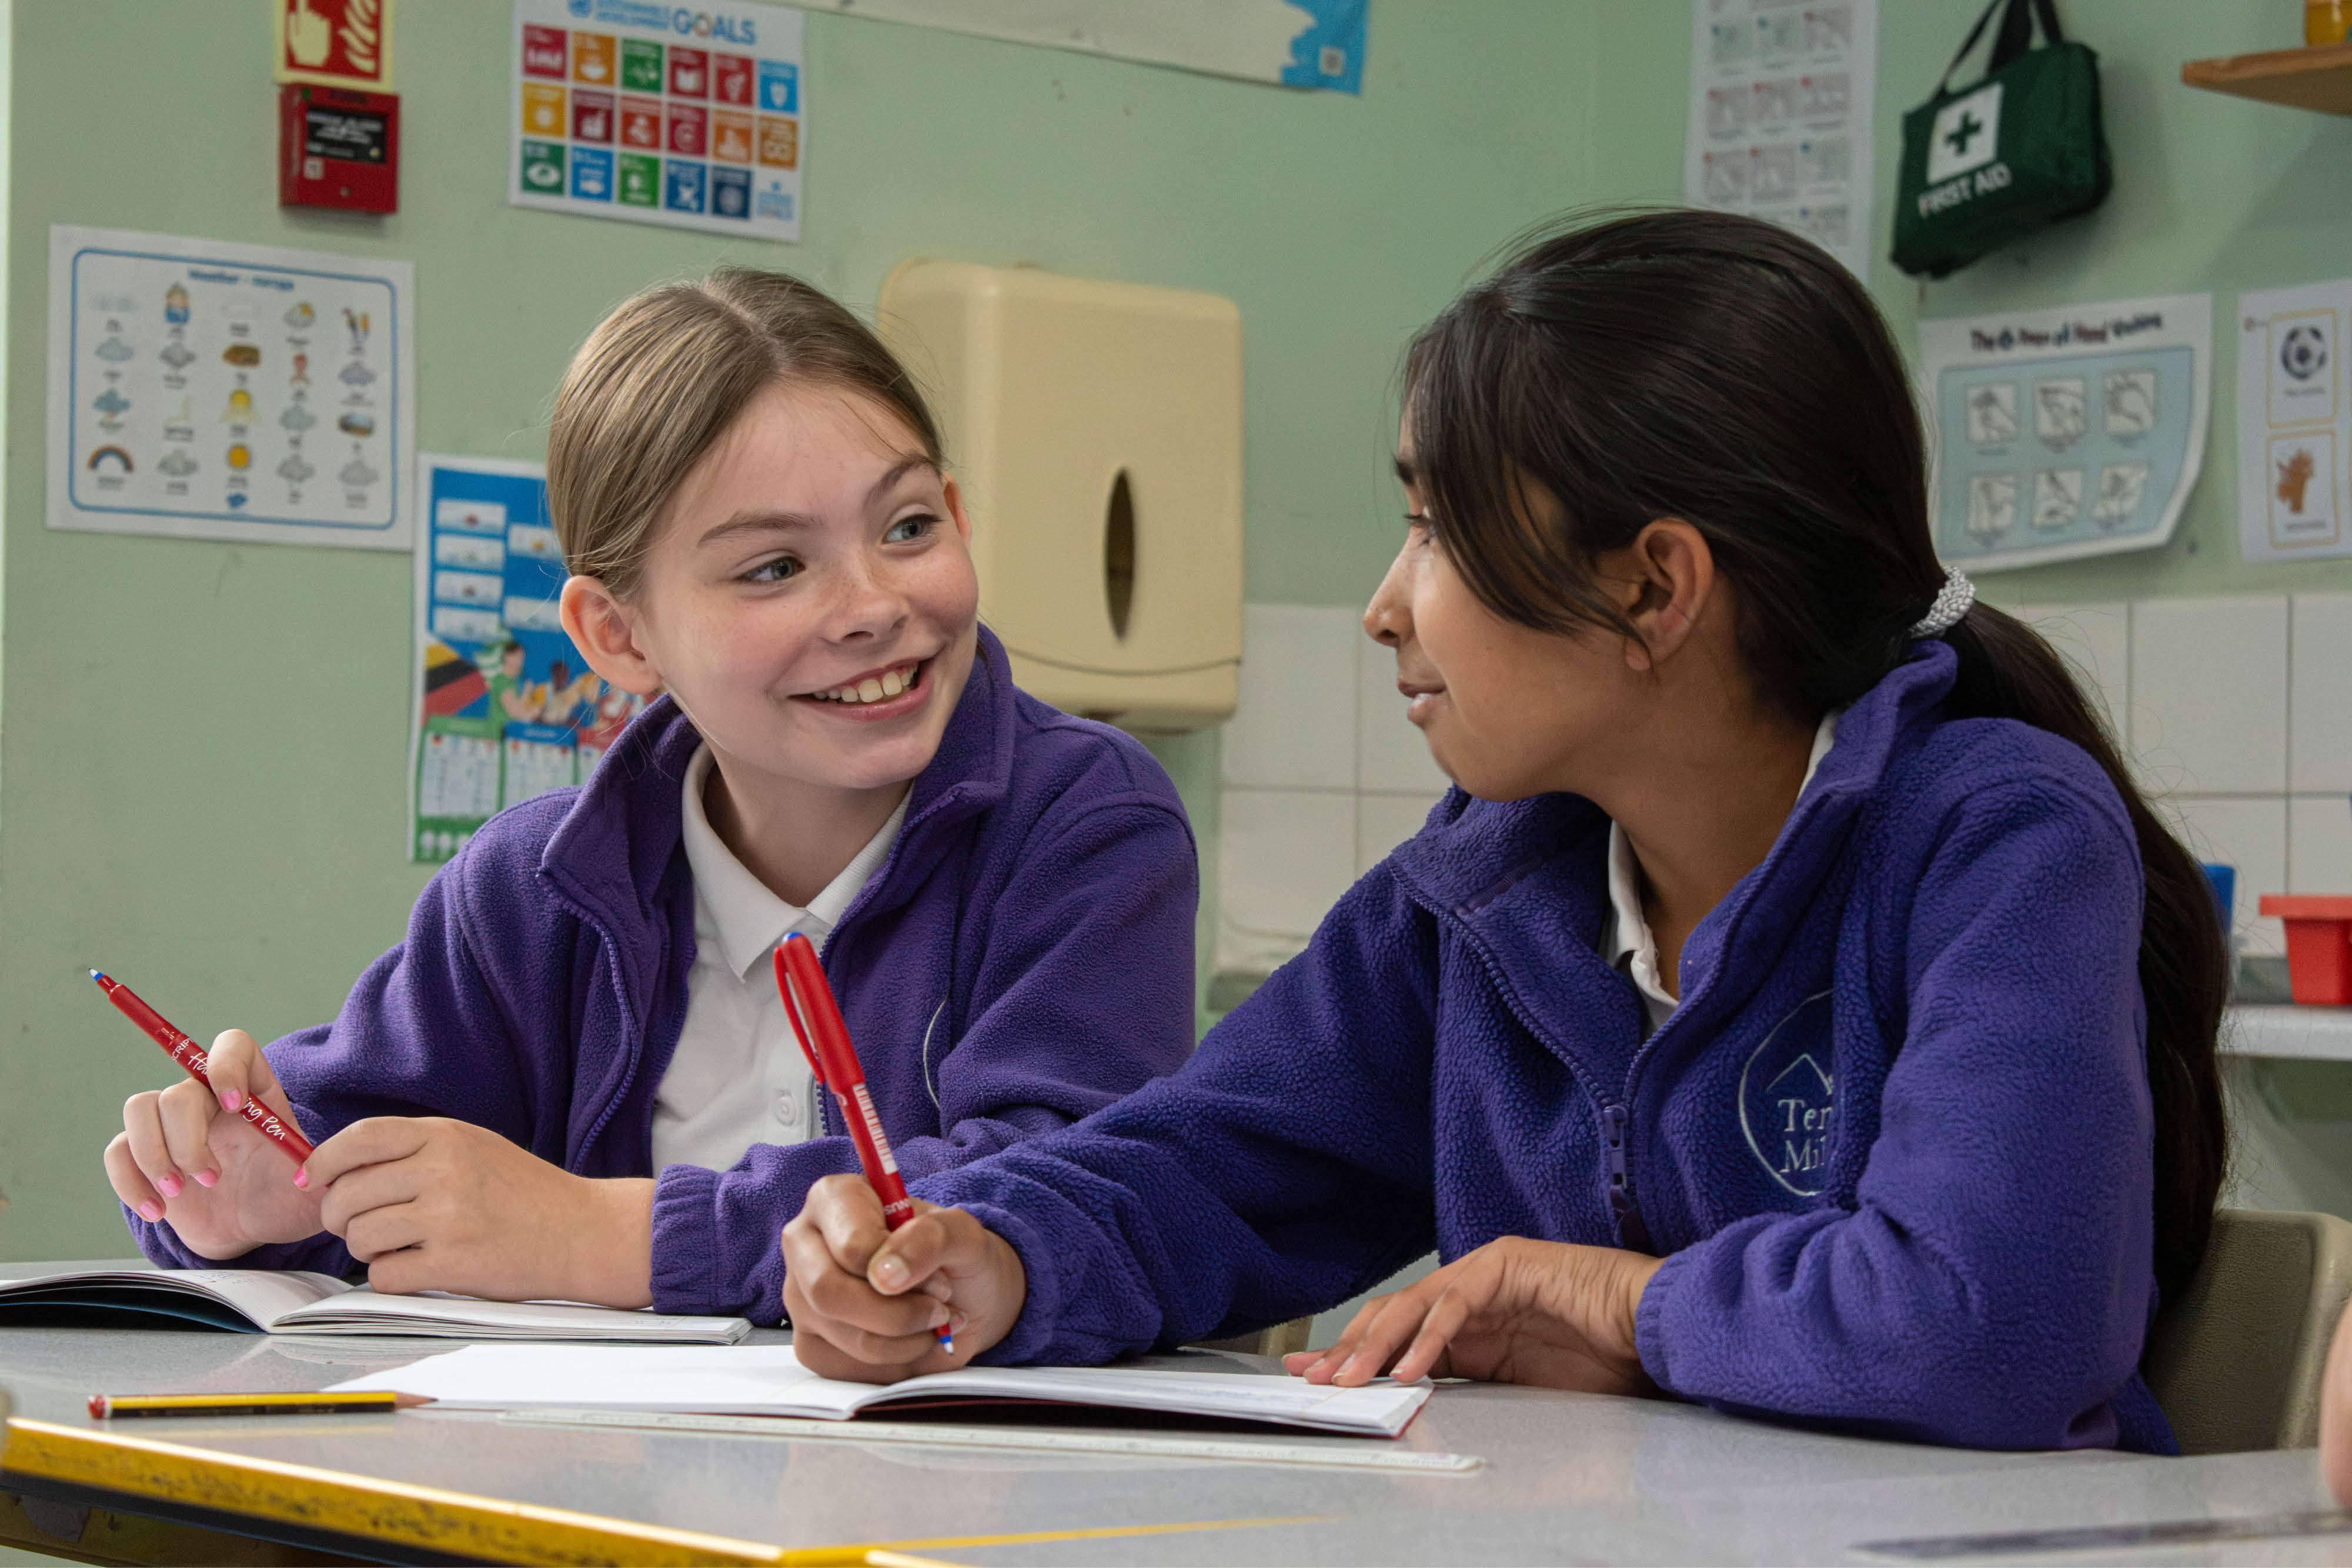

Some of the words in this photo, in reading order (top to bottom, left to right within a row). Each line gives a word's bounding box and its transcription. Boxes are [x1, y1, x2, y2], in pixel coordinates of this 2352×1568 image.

[673, 7, 757, 45] GOALS
[1918, 176, 1972, 219] FIRST
[1975, 162, 2012, 196] AID
[261, 1115, 286, 1141] Pen
